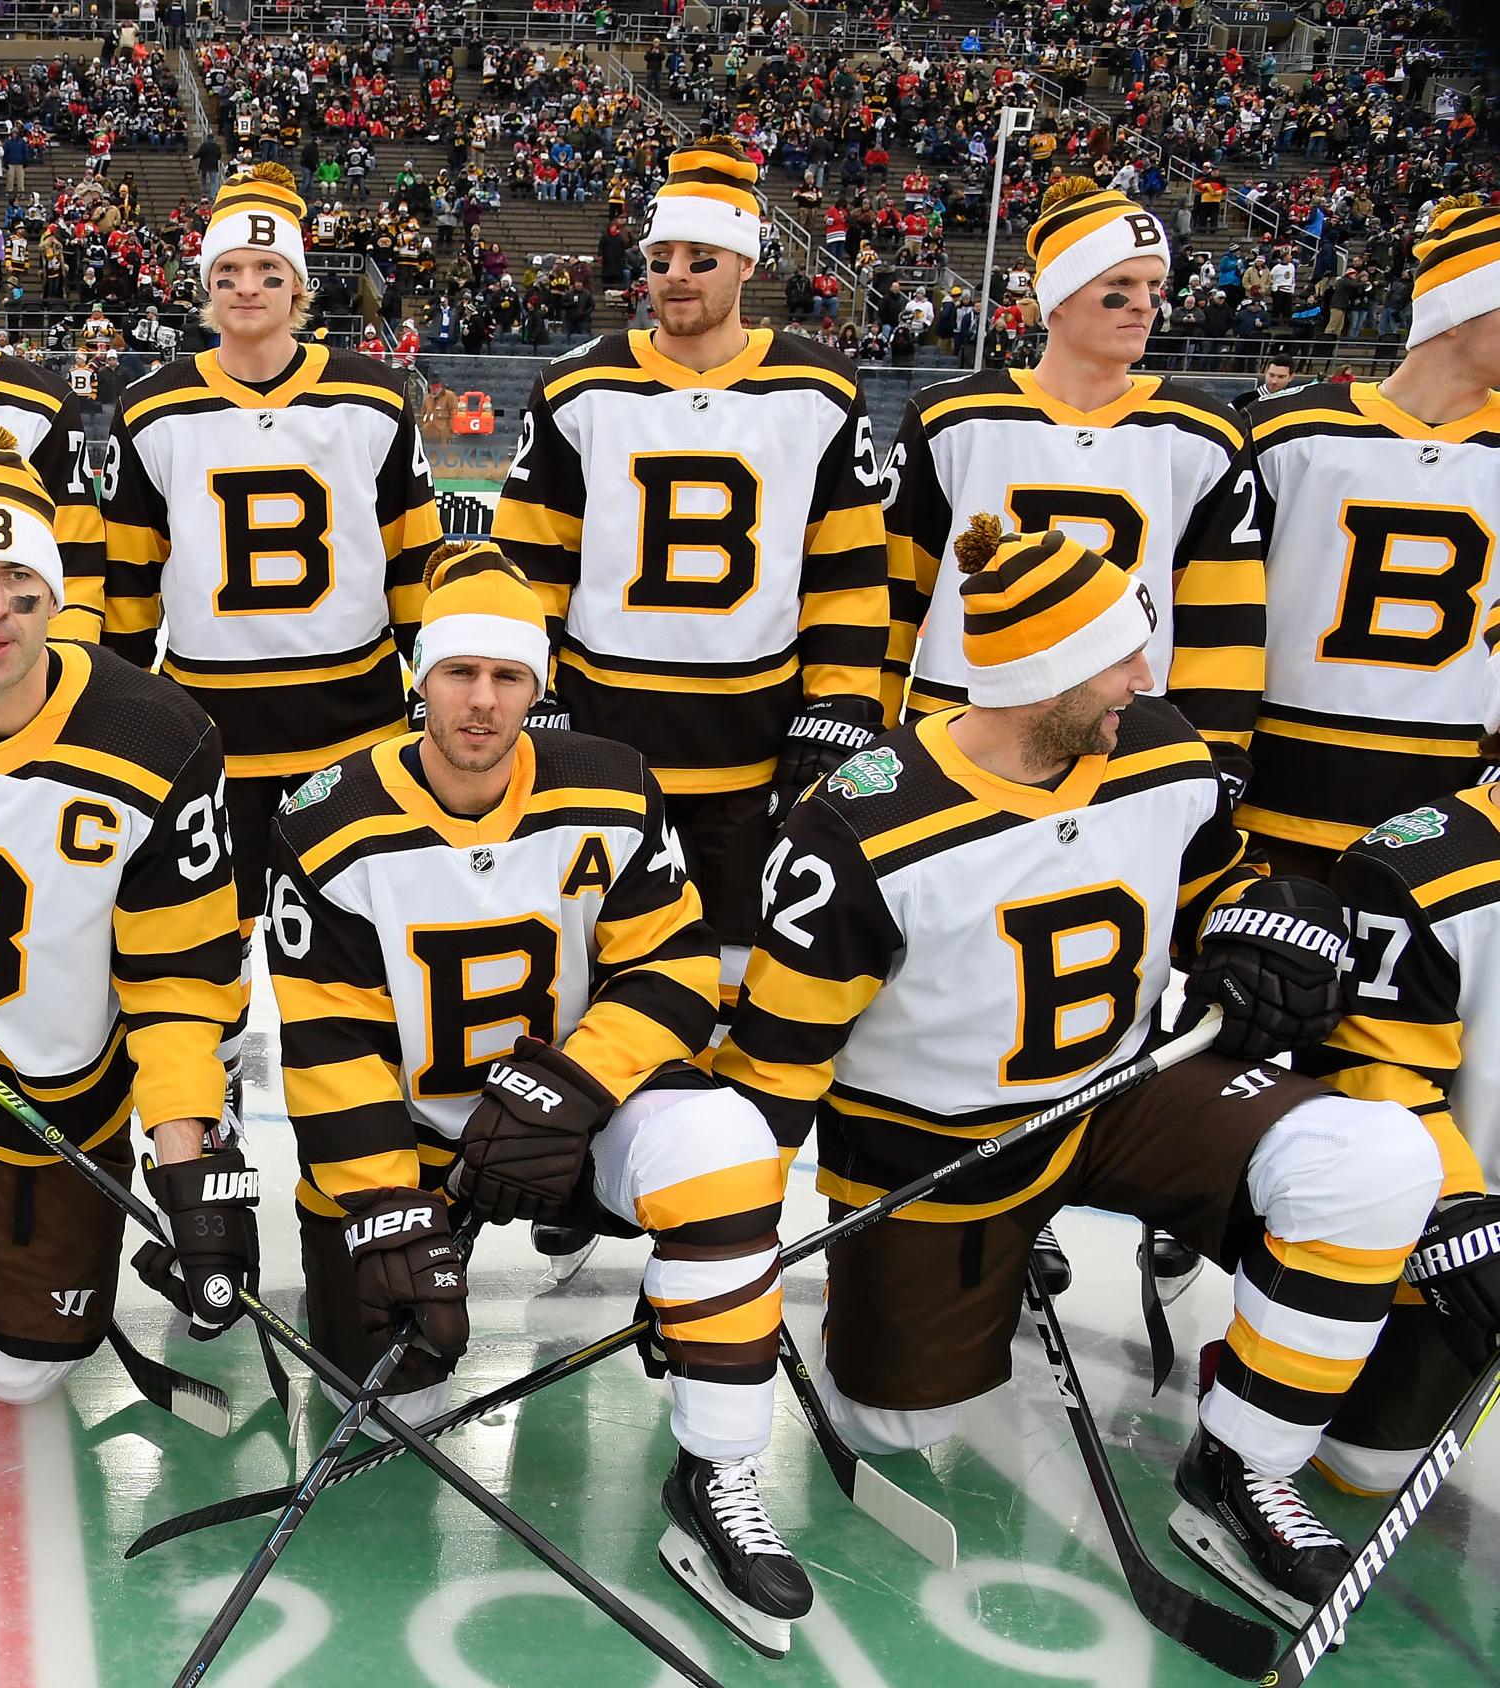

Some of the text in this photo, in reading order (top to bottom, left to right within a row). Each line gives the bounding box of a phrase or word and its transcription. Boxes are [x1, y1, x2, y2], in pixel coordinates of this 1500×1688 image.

[1234, 11, 1270, 22] 112 113
[247, 215, 276, 246] B
[1124, 214, 1162, 248] B
[467, 419, 479, 431] G
[508, 411, 534, 481] 2
[426, 447, 504, 469] OCKEY
[206, 463, 336, 617] B
[622, 450, 763, 615] B
[1135, 582, 1157, 634] B
[1314, 498, 1497, 672] B
[55, 796, 125, 868] C
[560, 832, 617, 901] A
[1200, 907, 1343, 963] WARRIOR
[406, 911, 566, 1101] B
[996, 878, 1148, 1088] B
[487, 1062, 563, 1113] UER
[1025, 1064, 1137, 1133] WARRIOR
[75, 1152, 99, 1172] CHARA
[932, 1160, 961, 1180] BACKES
[345, 1206, 434, 1258] UER
[259, 1309, 293, 1338] ALPHA
[1294, 1429, 1462, 1679] WARRIOR
